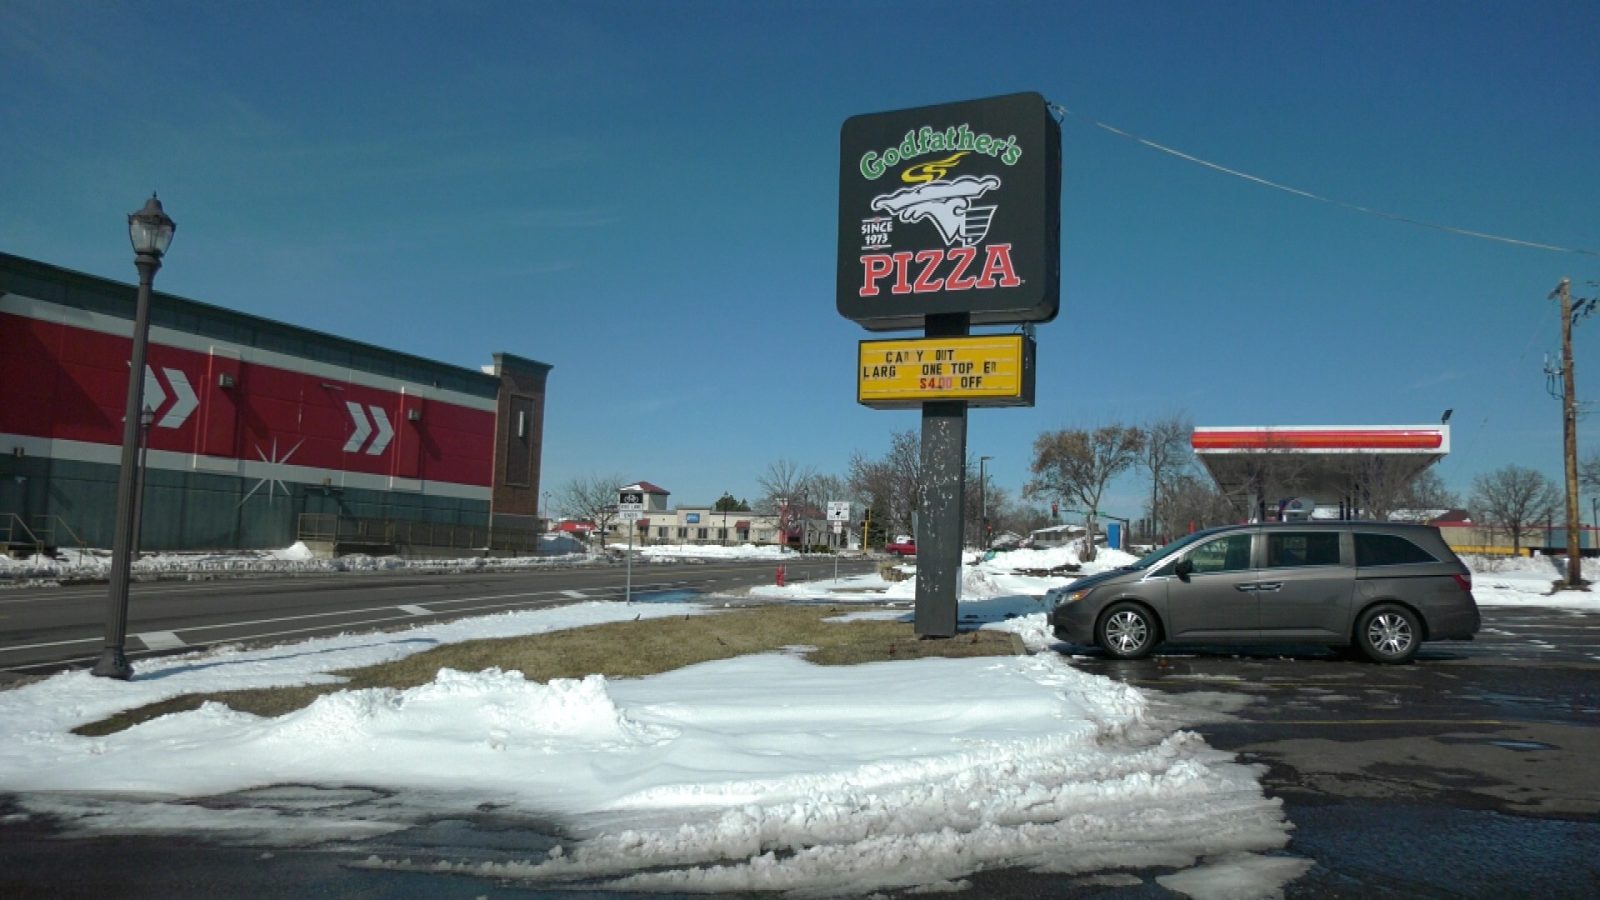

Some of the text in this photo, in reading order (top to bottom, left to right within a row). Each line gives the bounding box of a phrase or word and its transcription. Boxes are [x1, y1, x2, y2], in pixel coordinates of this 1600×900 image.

[860, 123, 1022, 180] Godfather's
[861, 221, 893, 235] SINCE
[865, 233, 888, 245] 1973
[859, 243, 1021, 297] PIZZA
[922, 363, 942, 376] ONE
[961, 376, 982, 388] OFF
